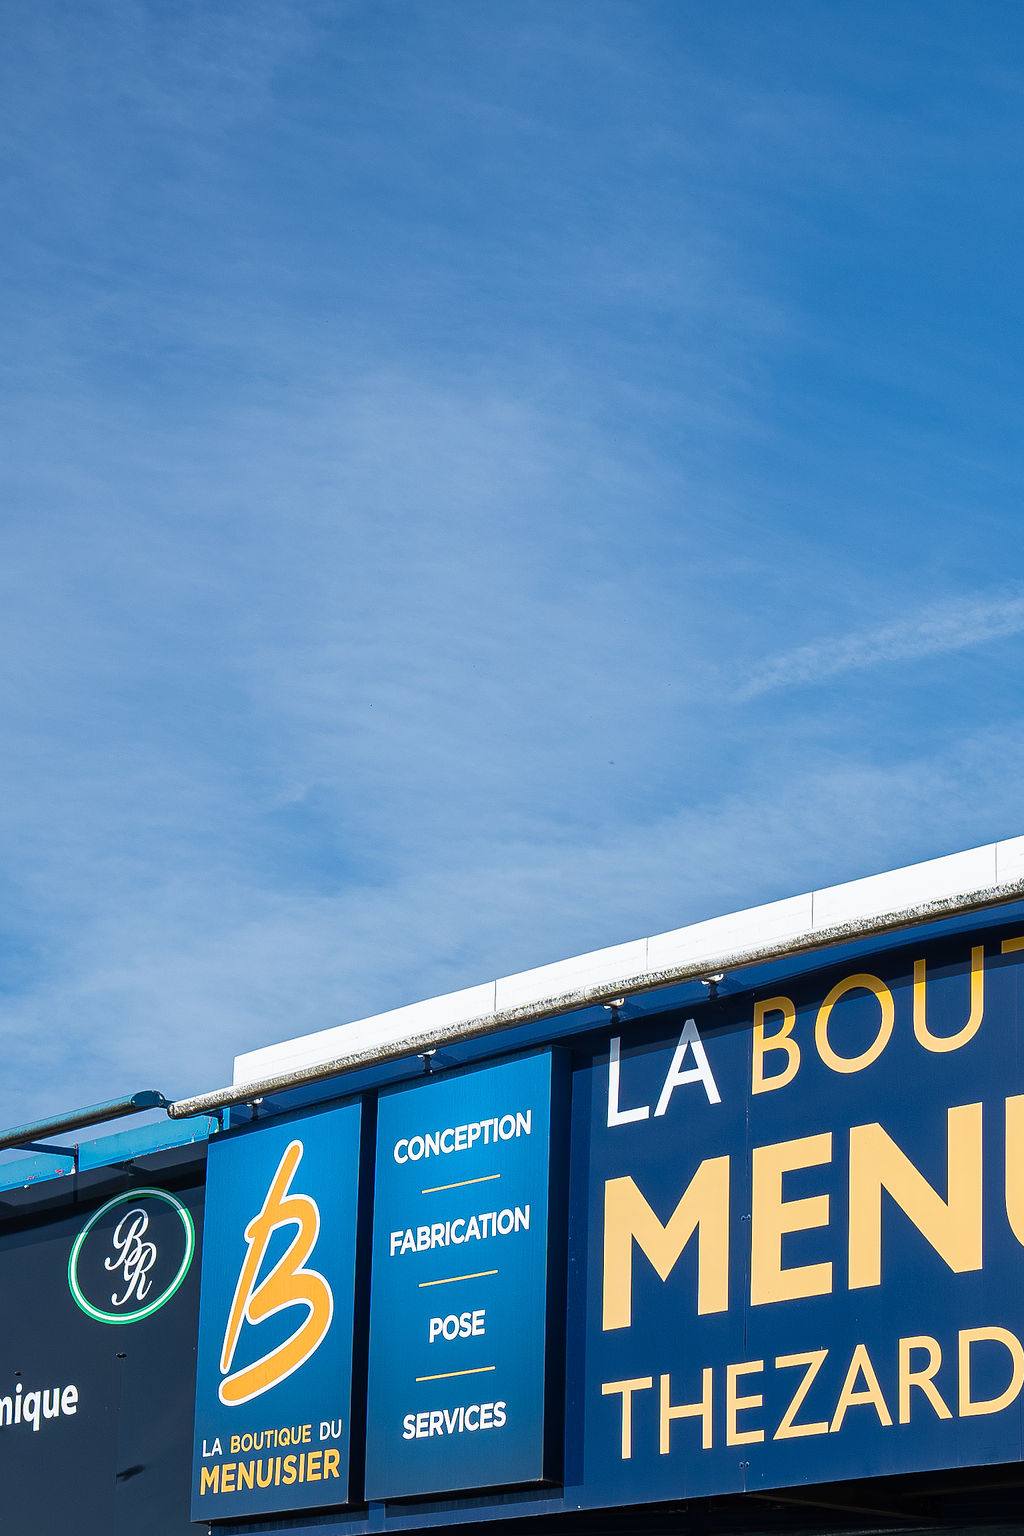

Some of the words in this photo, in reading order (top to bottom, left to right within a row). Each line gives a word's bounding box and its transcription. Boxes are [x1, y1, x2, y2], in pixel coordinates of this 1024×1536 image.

[606, 1018, 722, 1127] LA
[393, 1109, 532, 1164] CONCEPTION
[389, 1205, 531, 1257] FABRICATION
[428, 1310, 486, 1343] POSE
[202, 1437, 223, 1458] LA
[229, 1424, 311, 1454] BOUTIQUE
[319, 1419, 342, 1440] DU
[402, 1401, 507, 1440] SERVICES
[200, 1448, 340, 1496] MENUISIER
